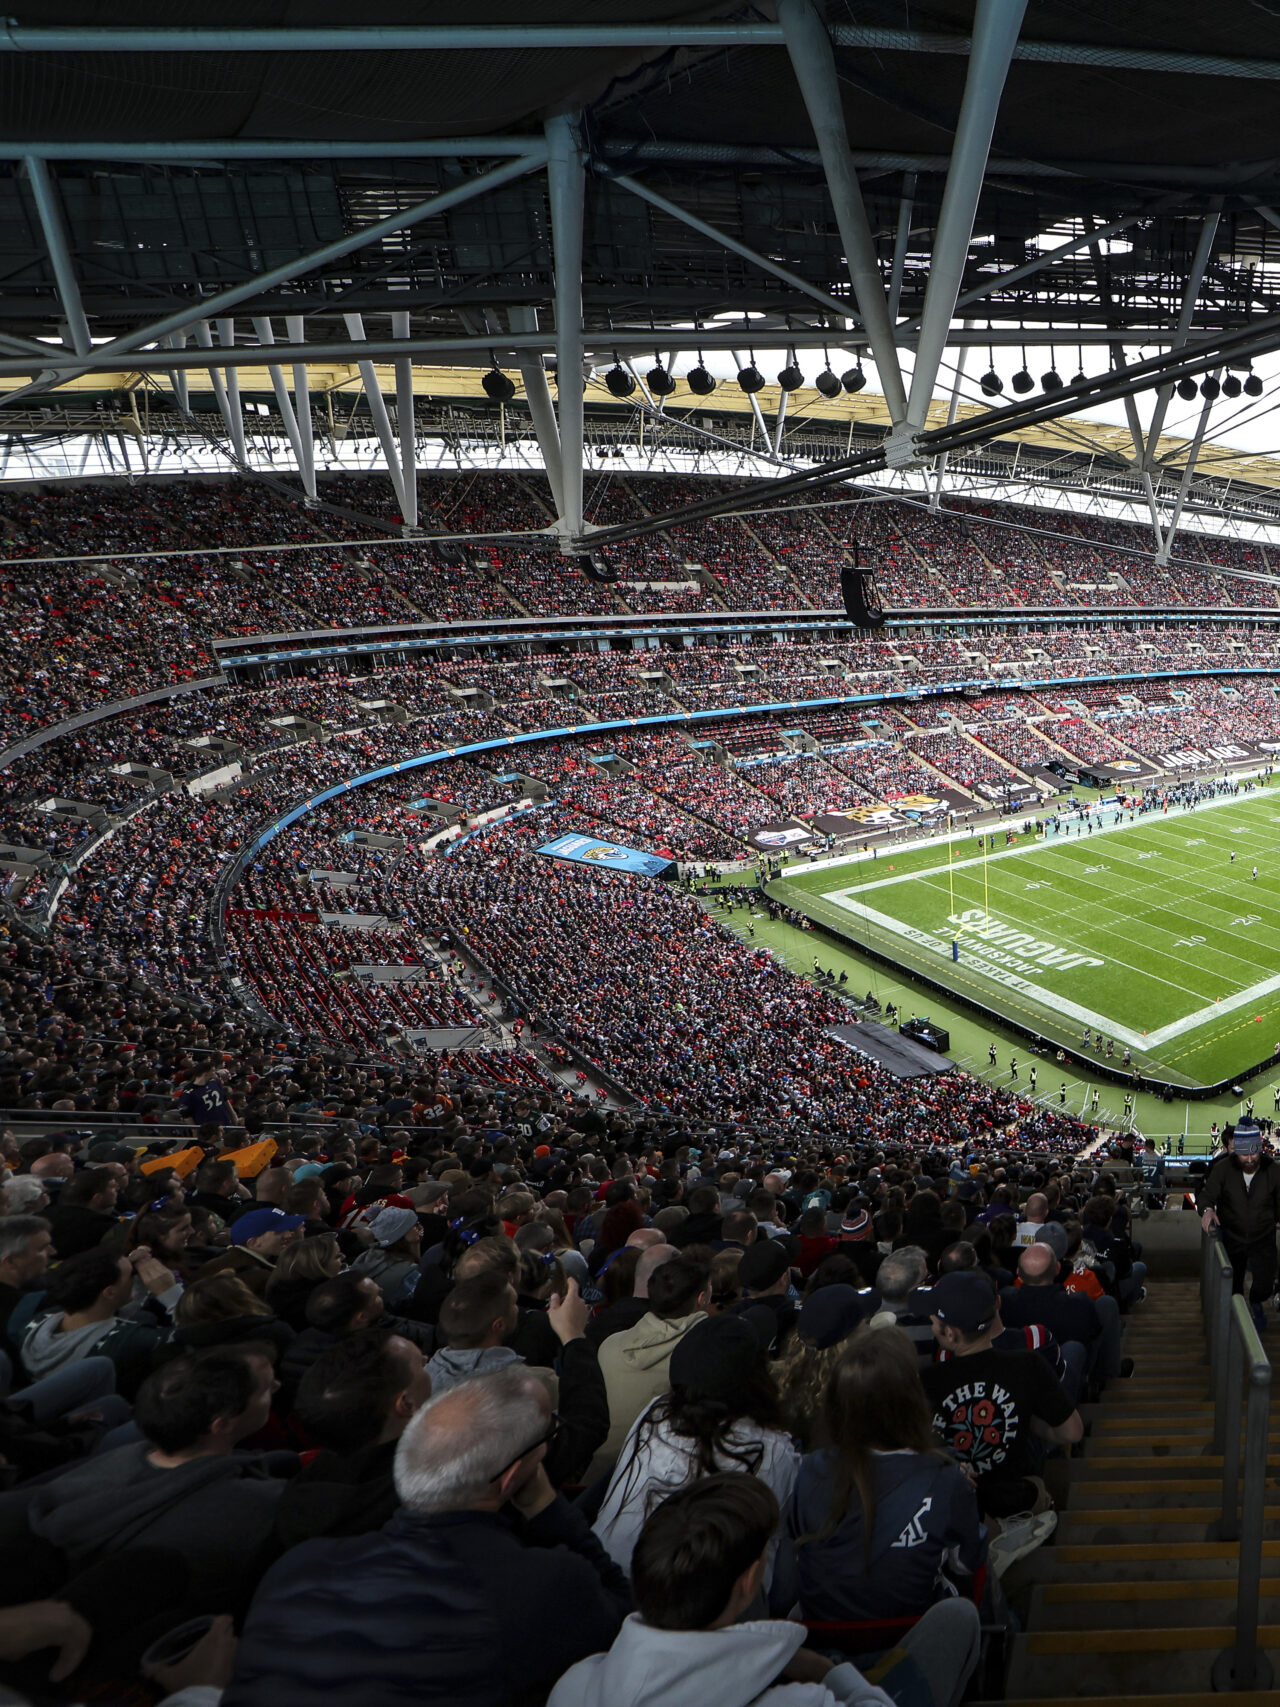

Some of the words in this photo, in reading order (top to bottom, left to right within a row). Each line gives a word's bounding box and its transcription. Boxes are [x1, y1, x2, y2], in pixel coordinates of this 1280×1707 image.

[1234, 914, 1262, 926] 20
[947, 909, 1105, 971] JAGUARS
[1177, 934, 1207, 947] 10
[202, 1090, 223, 1112] 52
[423, 1103, 445, 1120] 32
[942, 1381, 986, 1412] THE
[991, 1382, 1020, 1443] WALL
